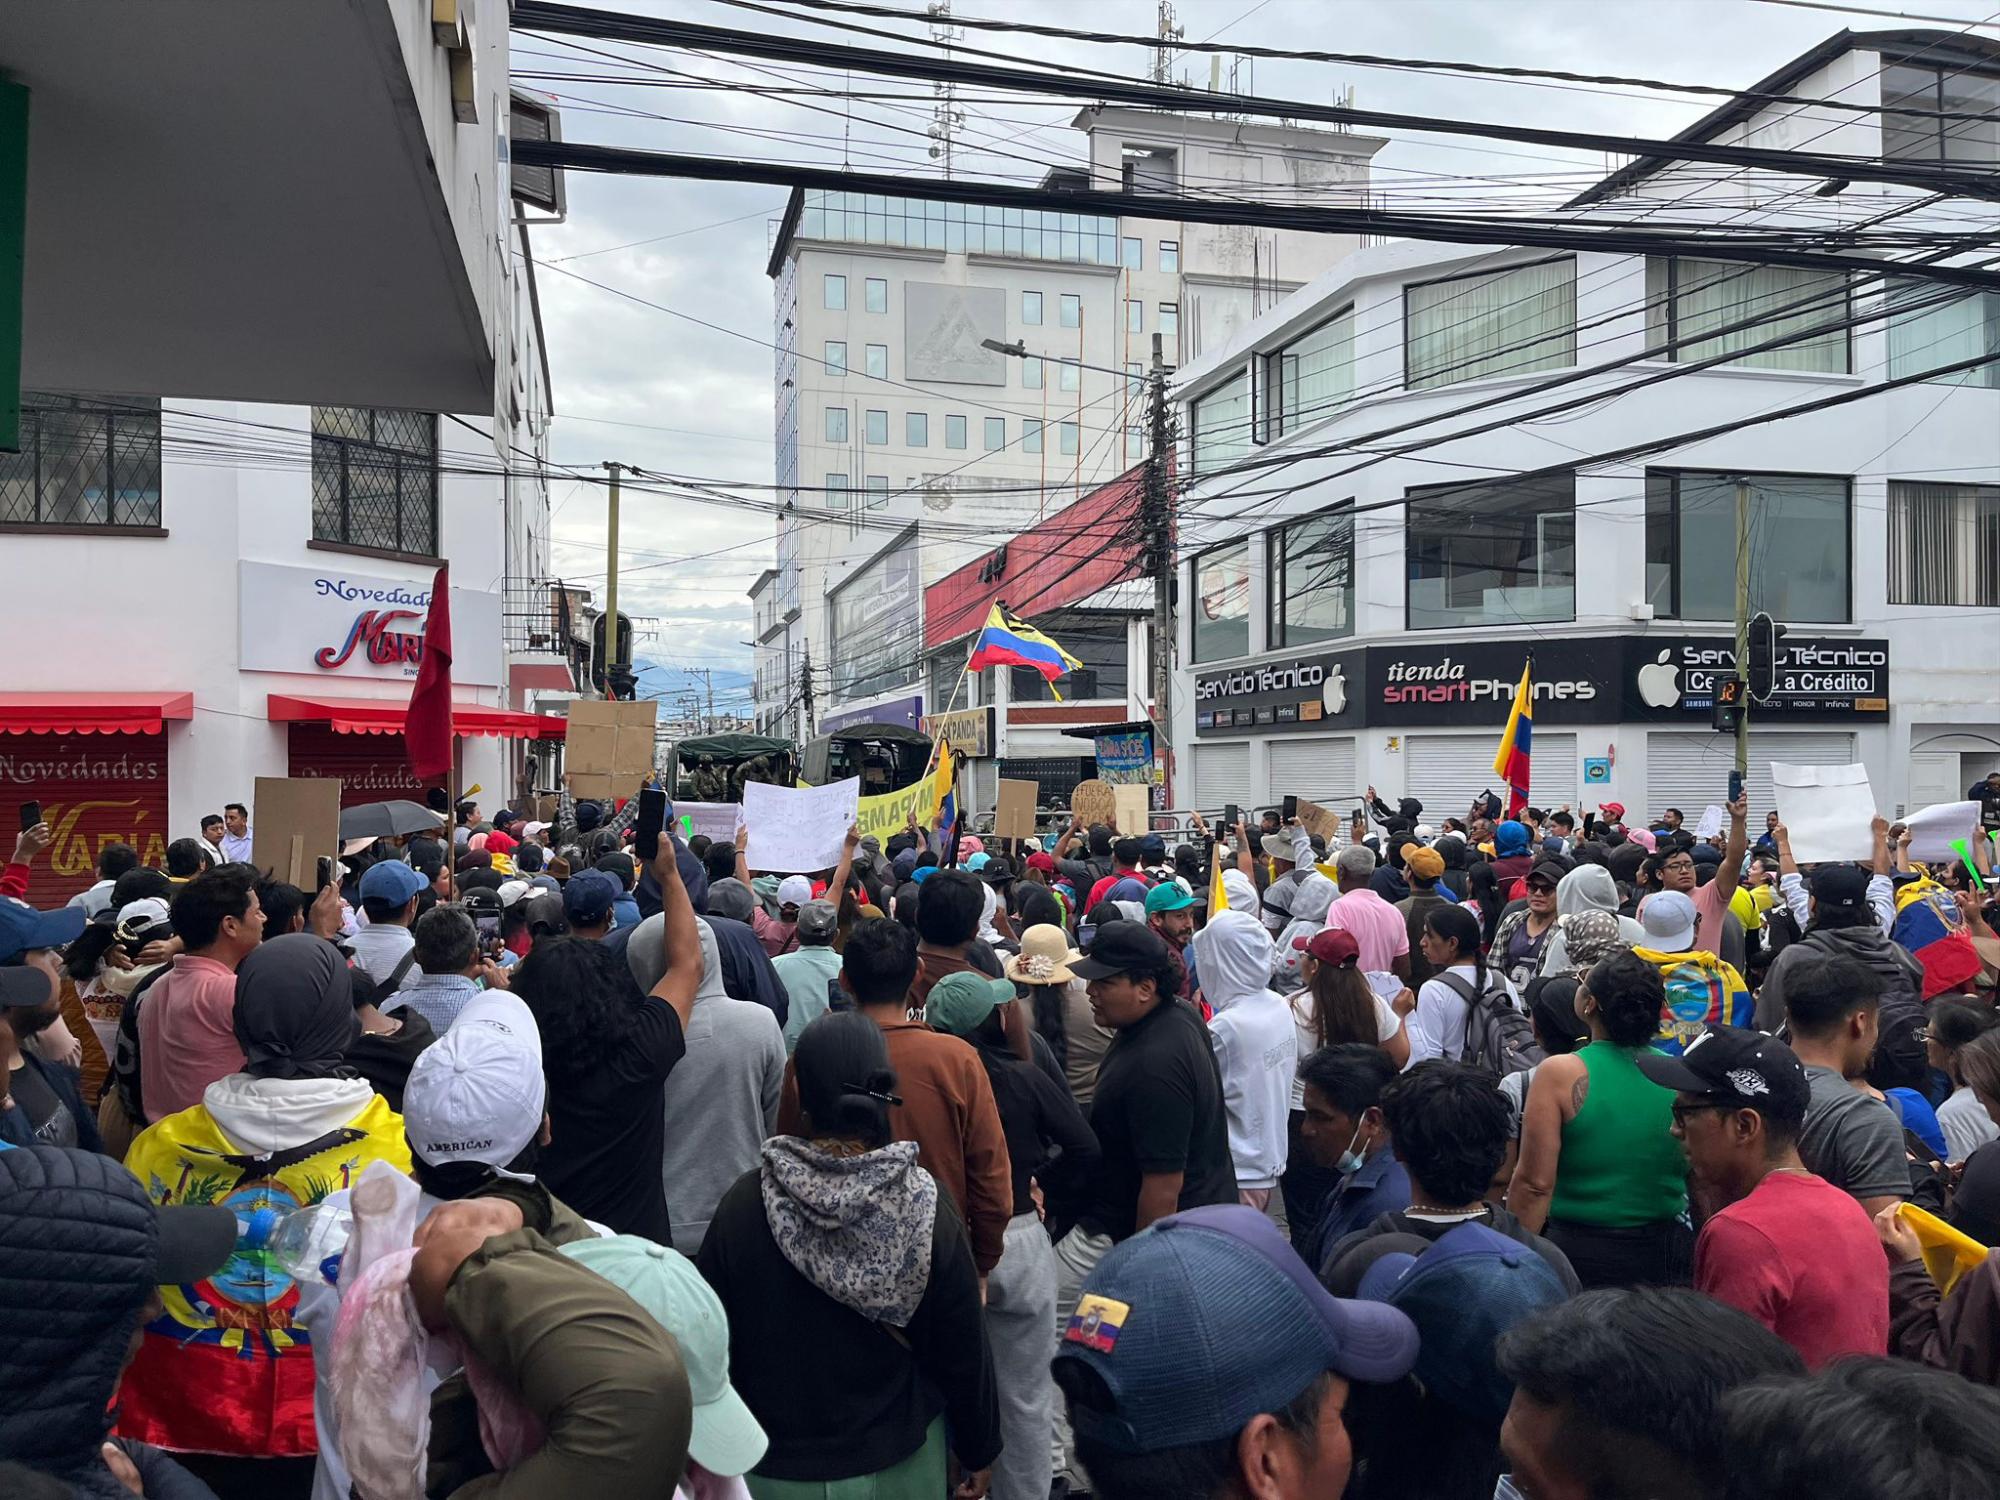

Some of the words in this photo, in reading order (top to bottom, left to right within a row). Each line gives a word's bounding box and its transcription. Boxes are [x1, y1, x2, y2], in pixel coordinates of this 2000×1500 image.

[315, 579, 433, 607] Novedad
[314, 609, 426, 669] MAR
[1789, 645, 1886, 666] Técnico
[1196, 672, 1255, 700] Servicio
[1256, 662, 1323, 692] Técnico
[1387, 657, 1466, 682] tienda
[1800, 672, 1869, 691] Crédito
[0, 753, 159, 784] Novedades
[302, 764, 424, 790] vedades
[426, 1139, 493, 1153] AMERICAN
